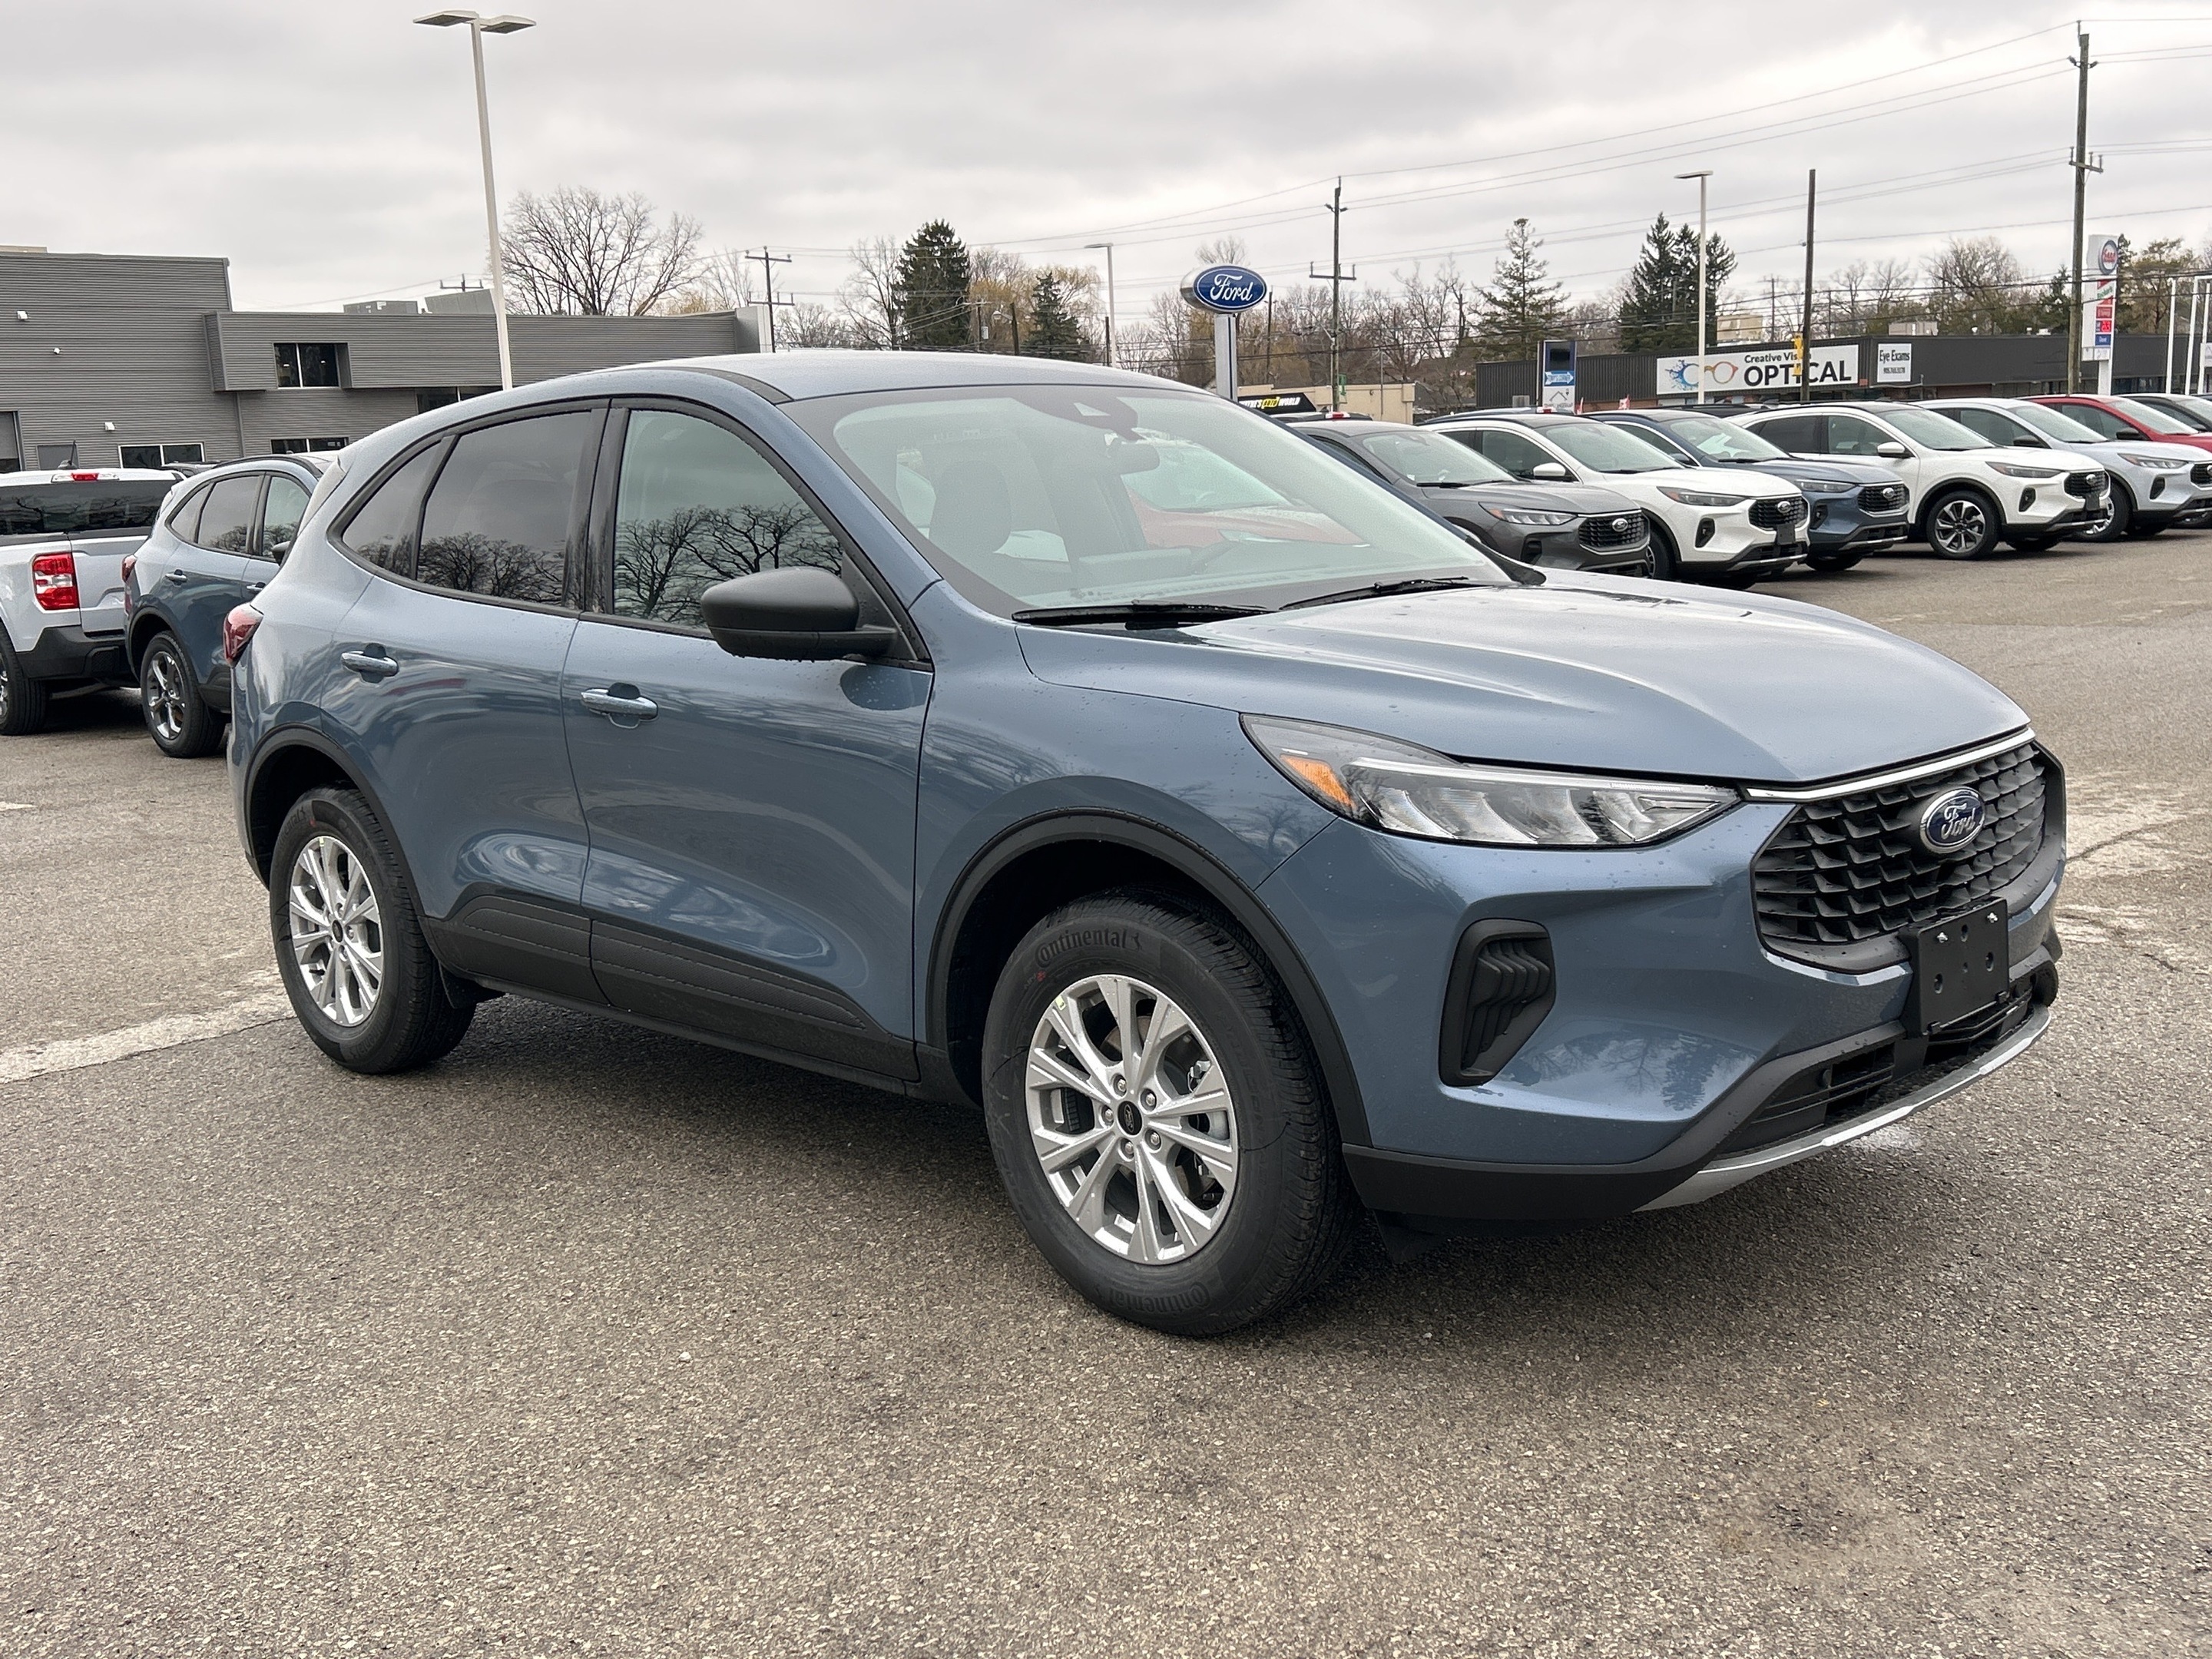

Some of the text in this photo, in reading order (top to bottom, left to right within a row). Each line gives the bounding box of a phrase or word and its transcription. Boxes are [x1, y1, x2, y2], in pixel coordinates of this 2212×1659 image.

[1210, 273, 1253, 301] Ford
[1744, 353, 1782, 363] Creative
[1879, 349, 1910, 364] Eye Exams
[1278, 397, 1300, 406] WORLD
[1941, 803, 1975, 839] Ford
[1035, 928, 1128, 968] Continental
